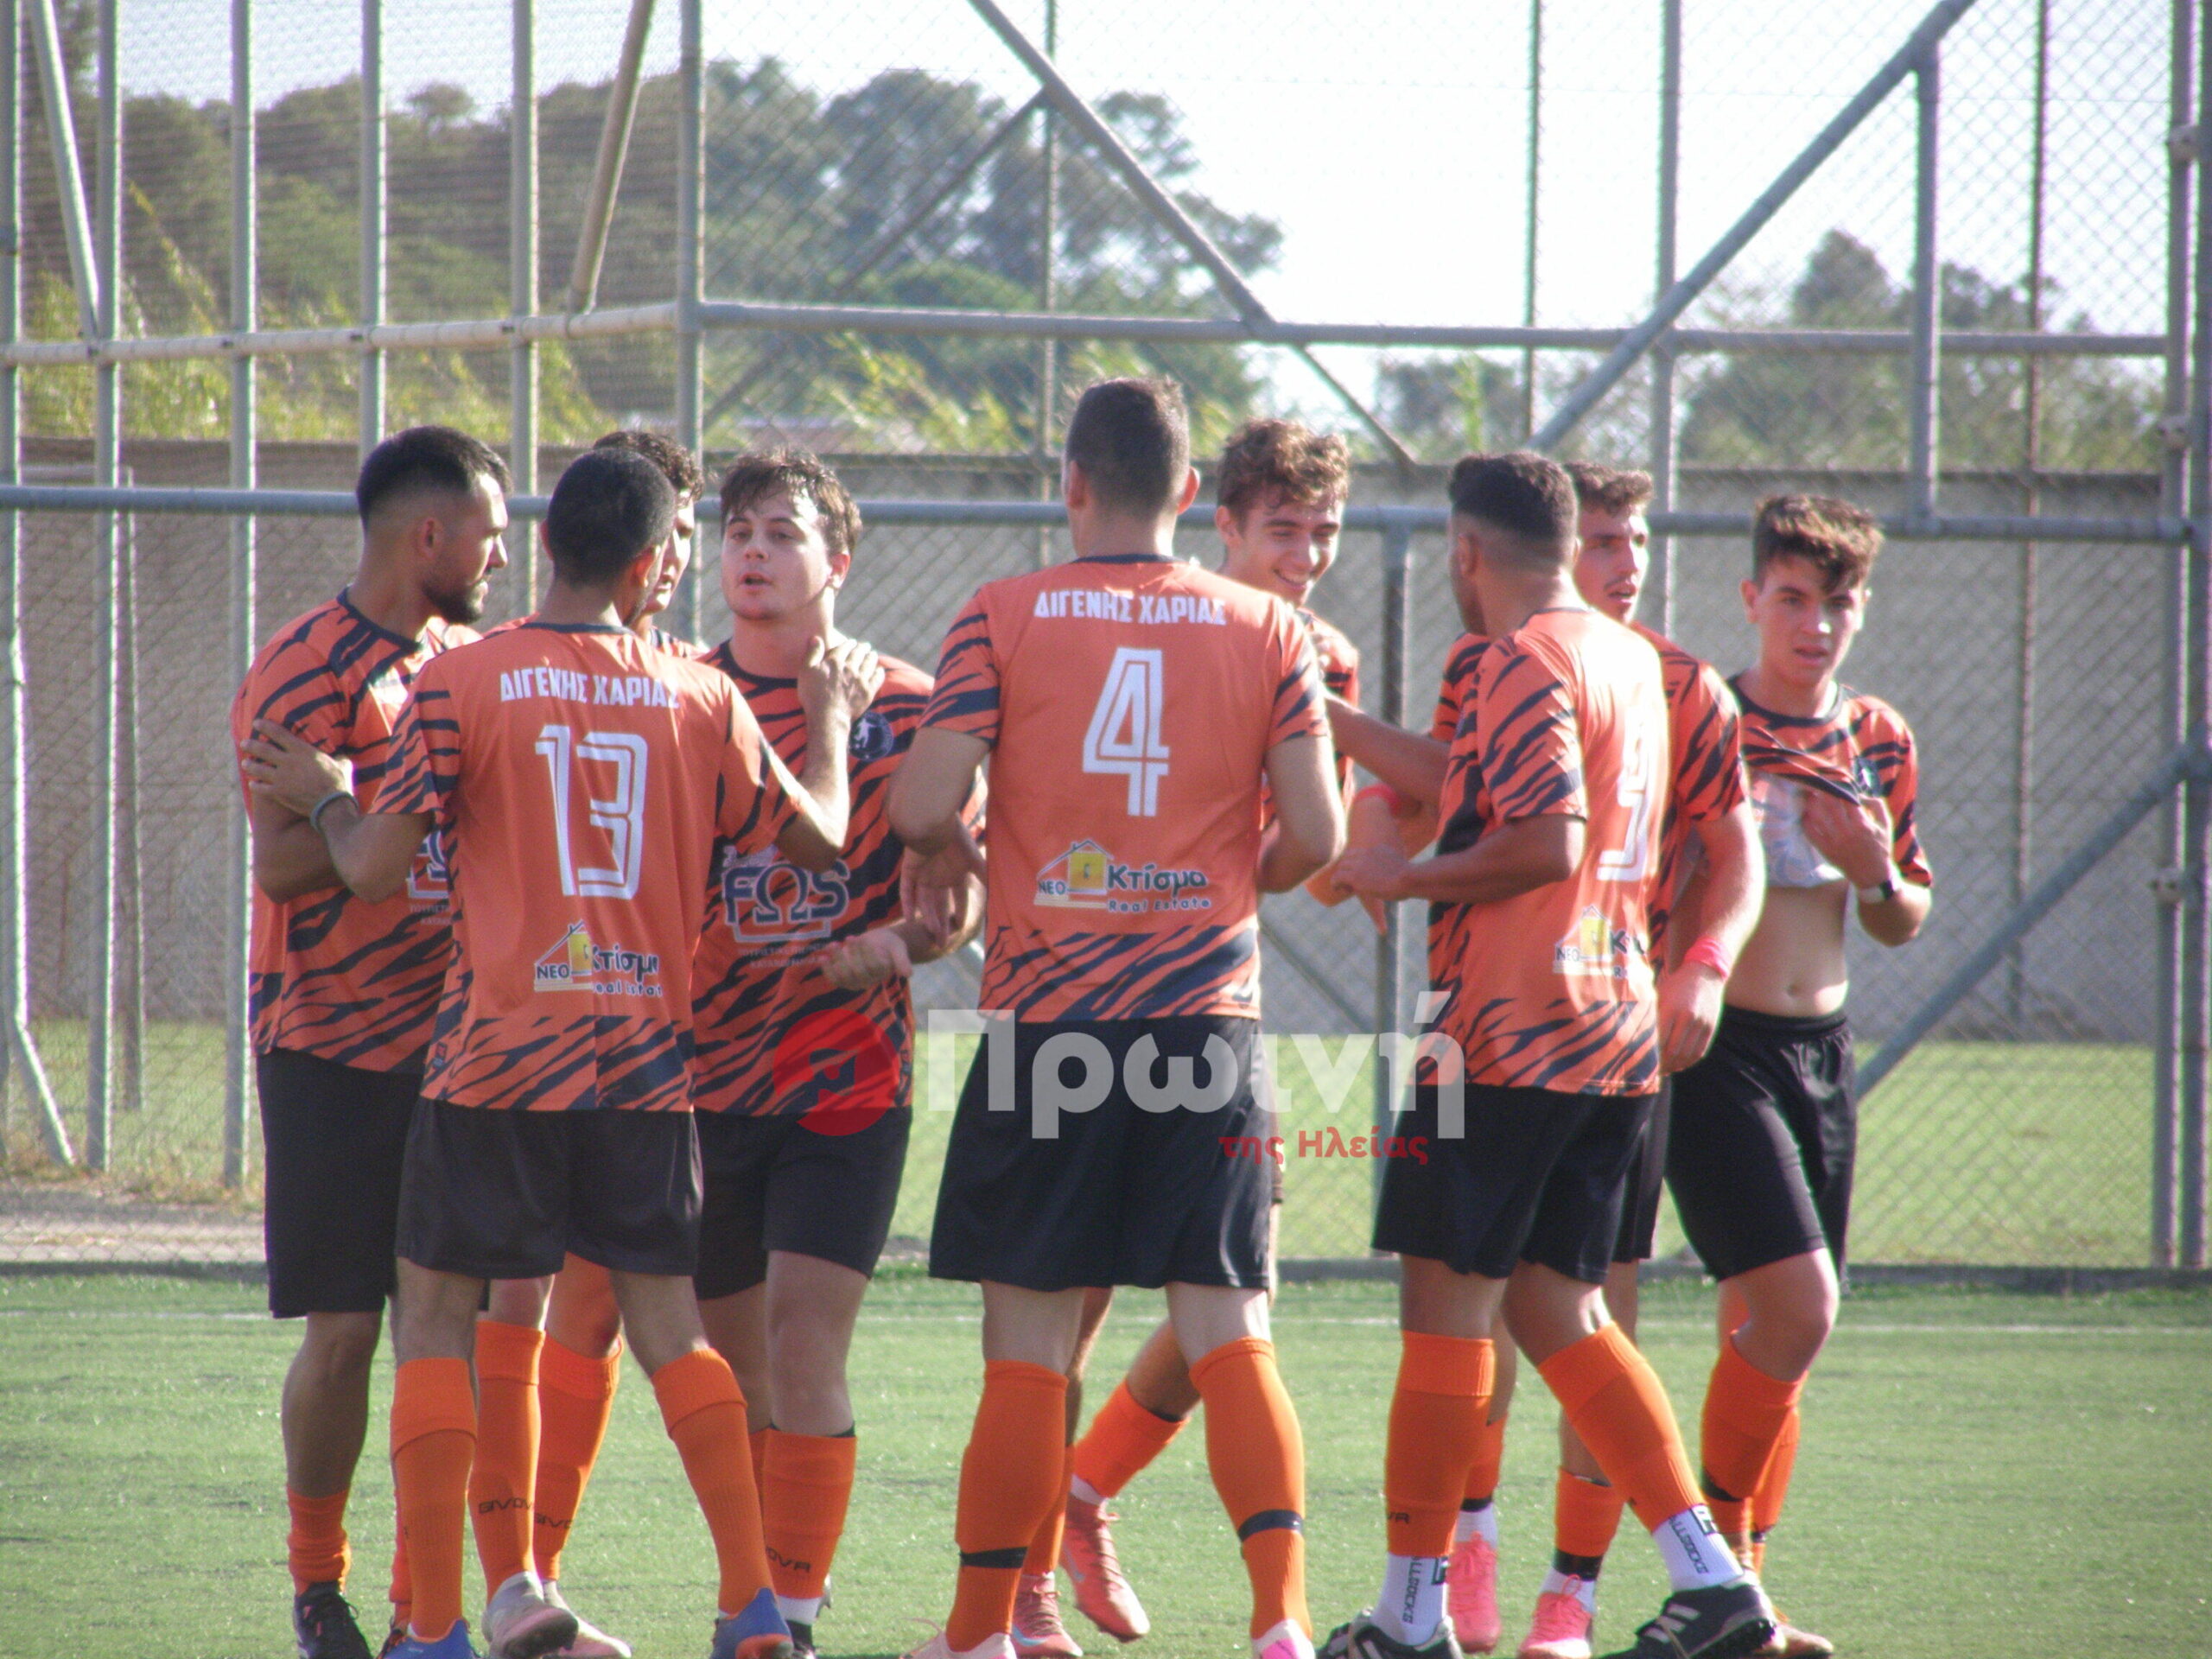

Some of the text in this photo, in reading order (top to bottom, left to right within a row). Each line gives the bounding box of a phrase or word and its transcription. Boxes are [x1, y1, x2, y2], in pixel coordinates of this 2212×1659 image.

[1033, 590, 1227, 626] ΔΙΓΕΝΗΣ ΧΑΡΙΑΣ
[1083, 646, 1170, 817] 4
[535, 724, 648, 899] 13
[1107, 864, 1208, 897] Κτίσμα
[594, 982, 621, 995] eal
